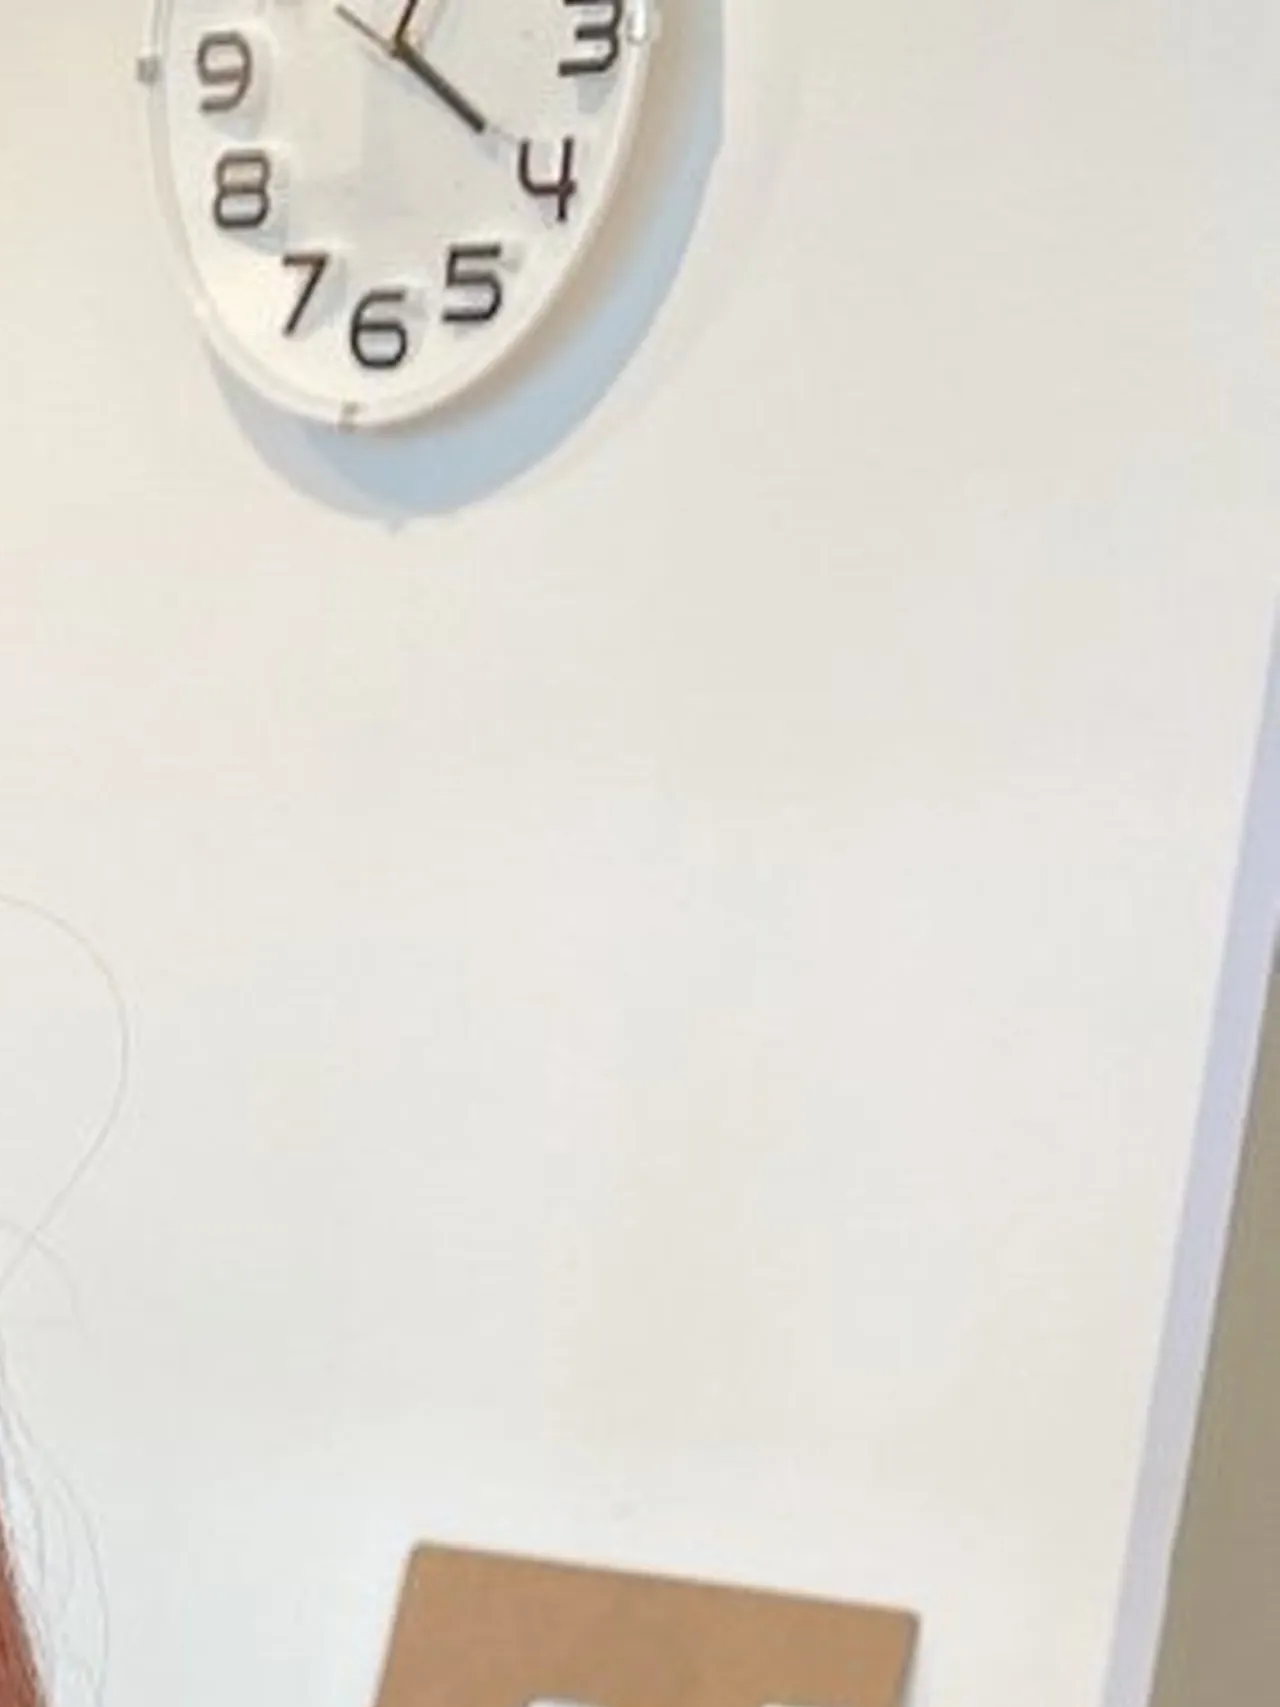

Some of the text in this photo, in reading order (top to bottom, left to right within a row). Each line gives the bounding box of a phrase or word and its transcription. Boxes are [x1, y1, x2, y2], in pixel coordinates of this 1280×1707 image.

[196, 31, 253, 113] 9
[557, 0, 624, 77] 3
[212, 149, 272, 230] 8
[517, 135, 577, 223] 4
[282, 251, 330, 338] 7
[442, 244, 504, 324] 5
[349, 289, 408, 370] 6
